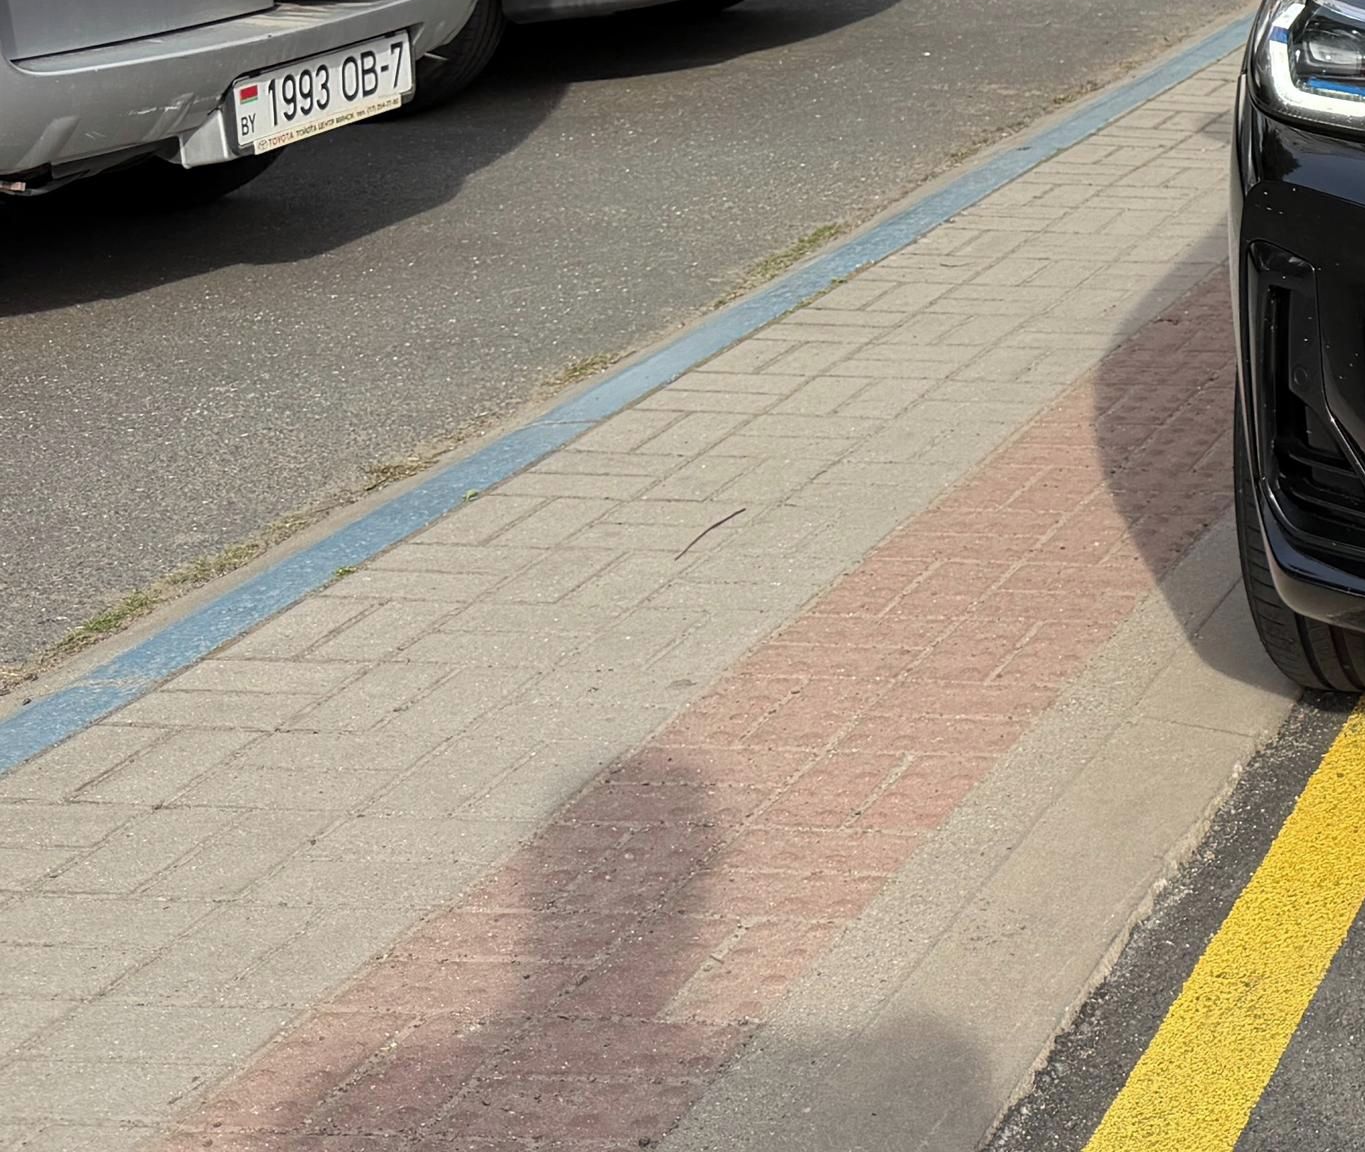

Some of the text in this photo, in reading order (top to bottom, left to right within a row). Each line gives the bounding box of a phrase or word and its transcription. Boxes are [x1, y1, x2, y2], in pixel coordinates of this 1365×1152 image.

[268, 64, 330, 127] 1993
[241, 113, 256, 136] BY
[268, 131, 295, 147] TOYOTA
